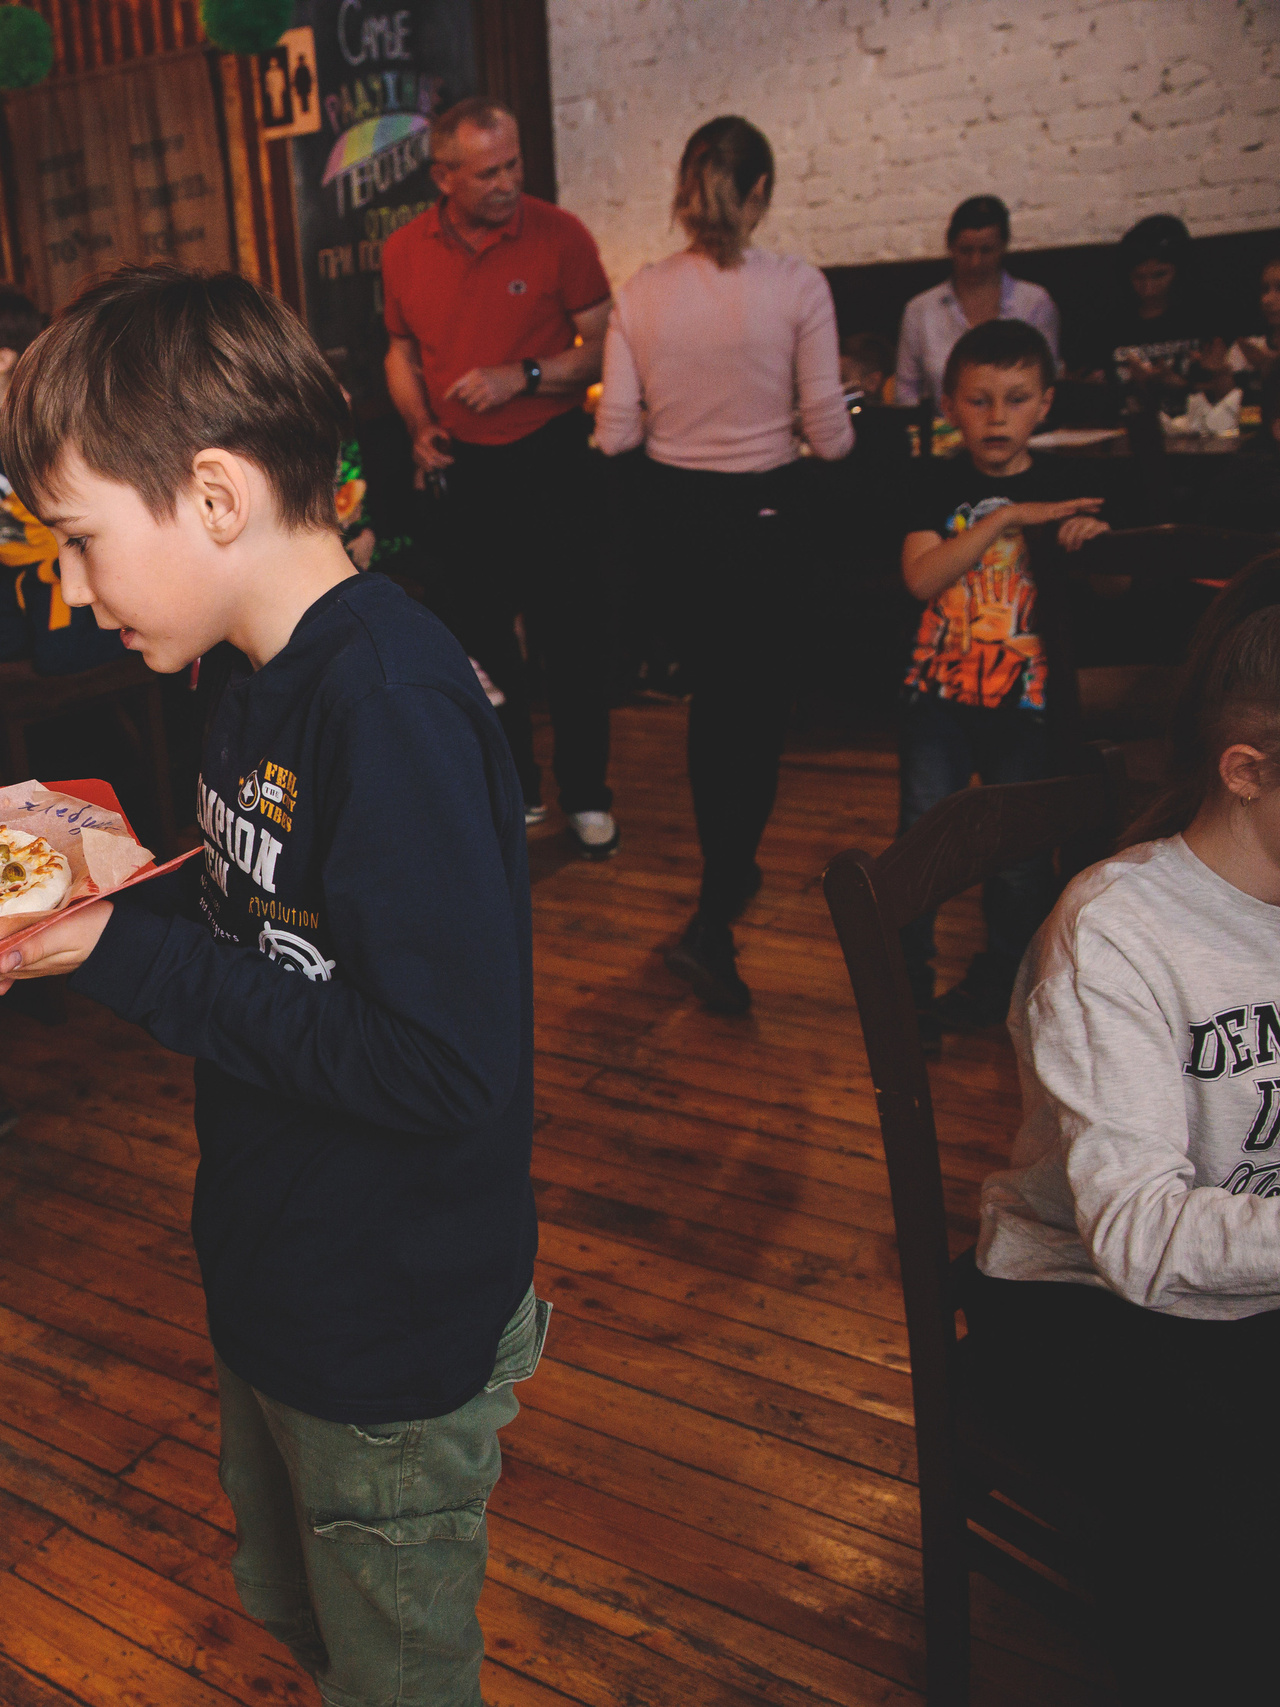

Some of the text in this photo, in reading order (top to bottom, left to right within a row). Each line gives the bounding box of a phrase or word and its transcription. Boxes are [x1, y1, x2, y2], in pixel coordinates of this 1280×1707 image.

[260, 797, 293, 833] VIBES
[264, 785, 281, 800] THE
[197, 773, 284, 894] AMPION
[1182, 1001, 1280, 1082] DEN
